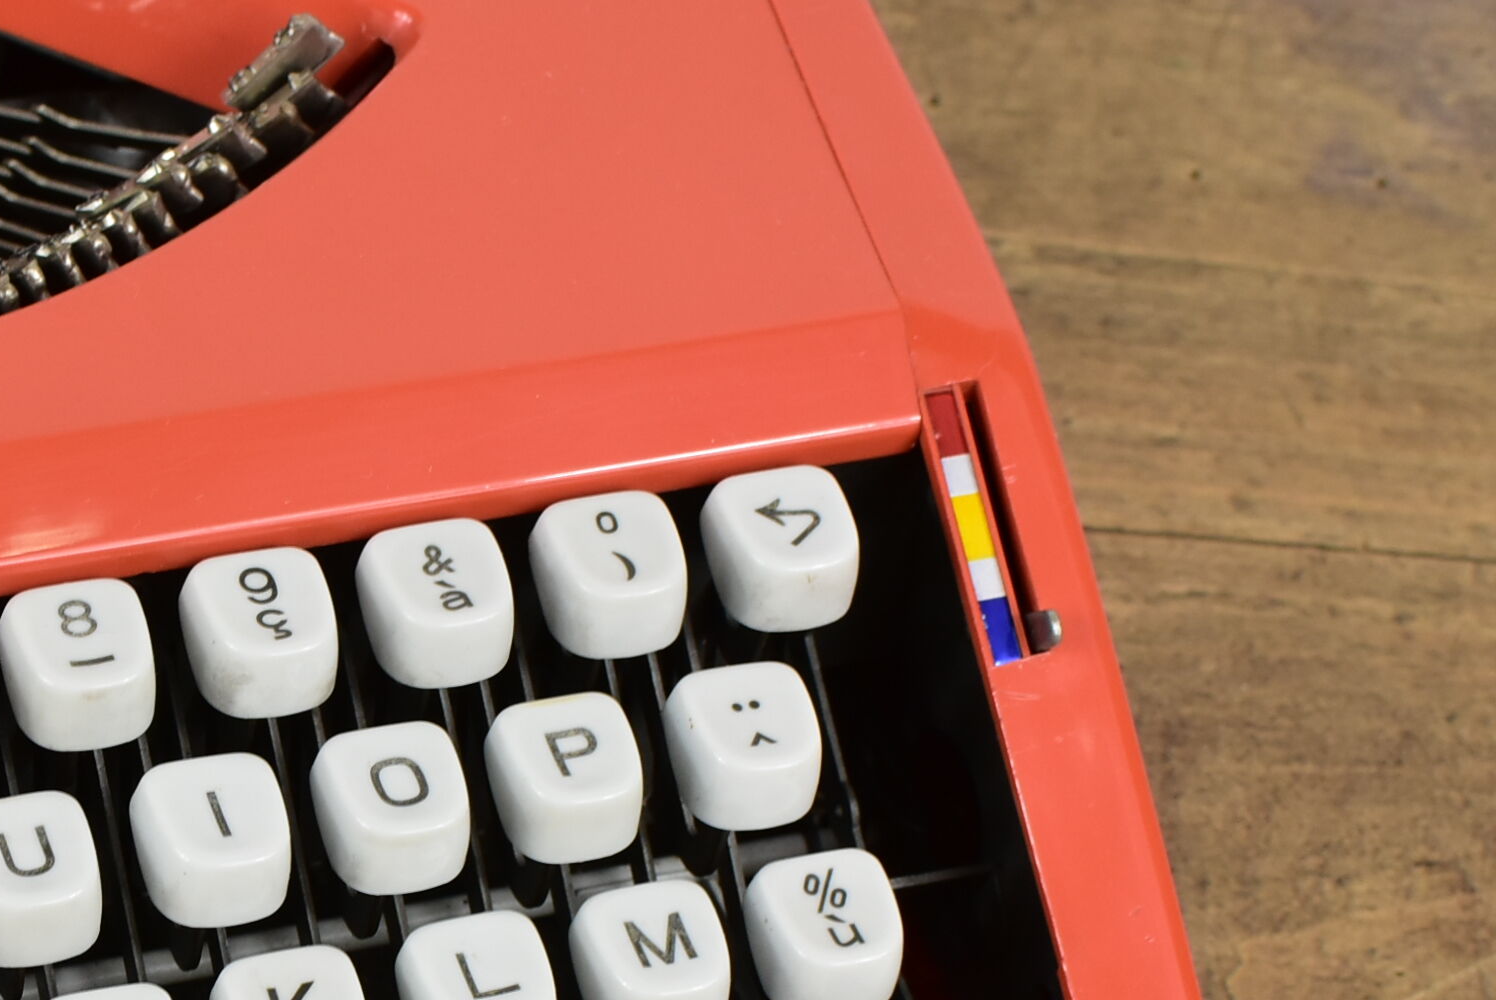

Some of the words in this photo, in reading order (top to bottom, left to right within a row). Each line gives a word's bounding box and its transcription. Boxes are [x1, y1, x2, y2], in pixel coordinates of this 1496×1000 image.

[422, 544, 455, 577] &
[238, 566, 279, 605] 9
[57, 599, 98, 638] 8
[544, 727, 598, 777] P
[369, 756, 430, 808] O
[206, 791, 233, 838] I
[802, 867, 848, 914] %
[623, 911, 699, 968] M
[455, 952, 521, 1000] L
